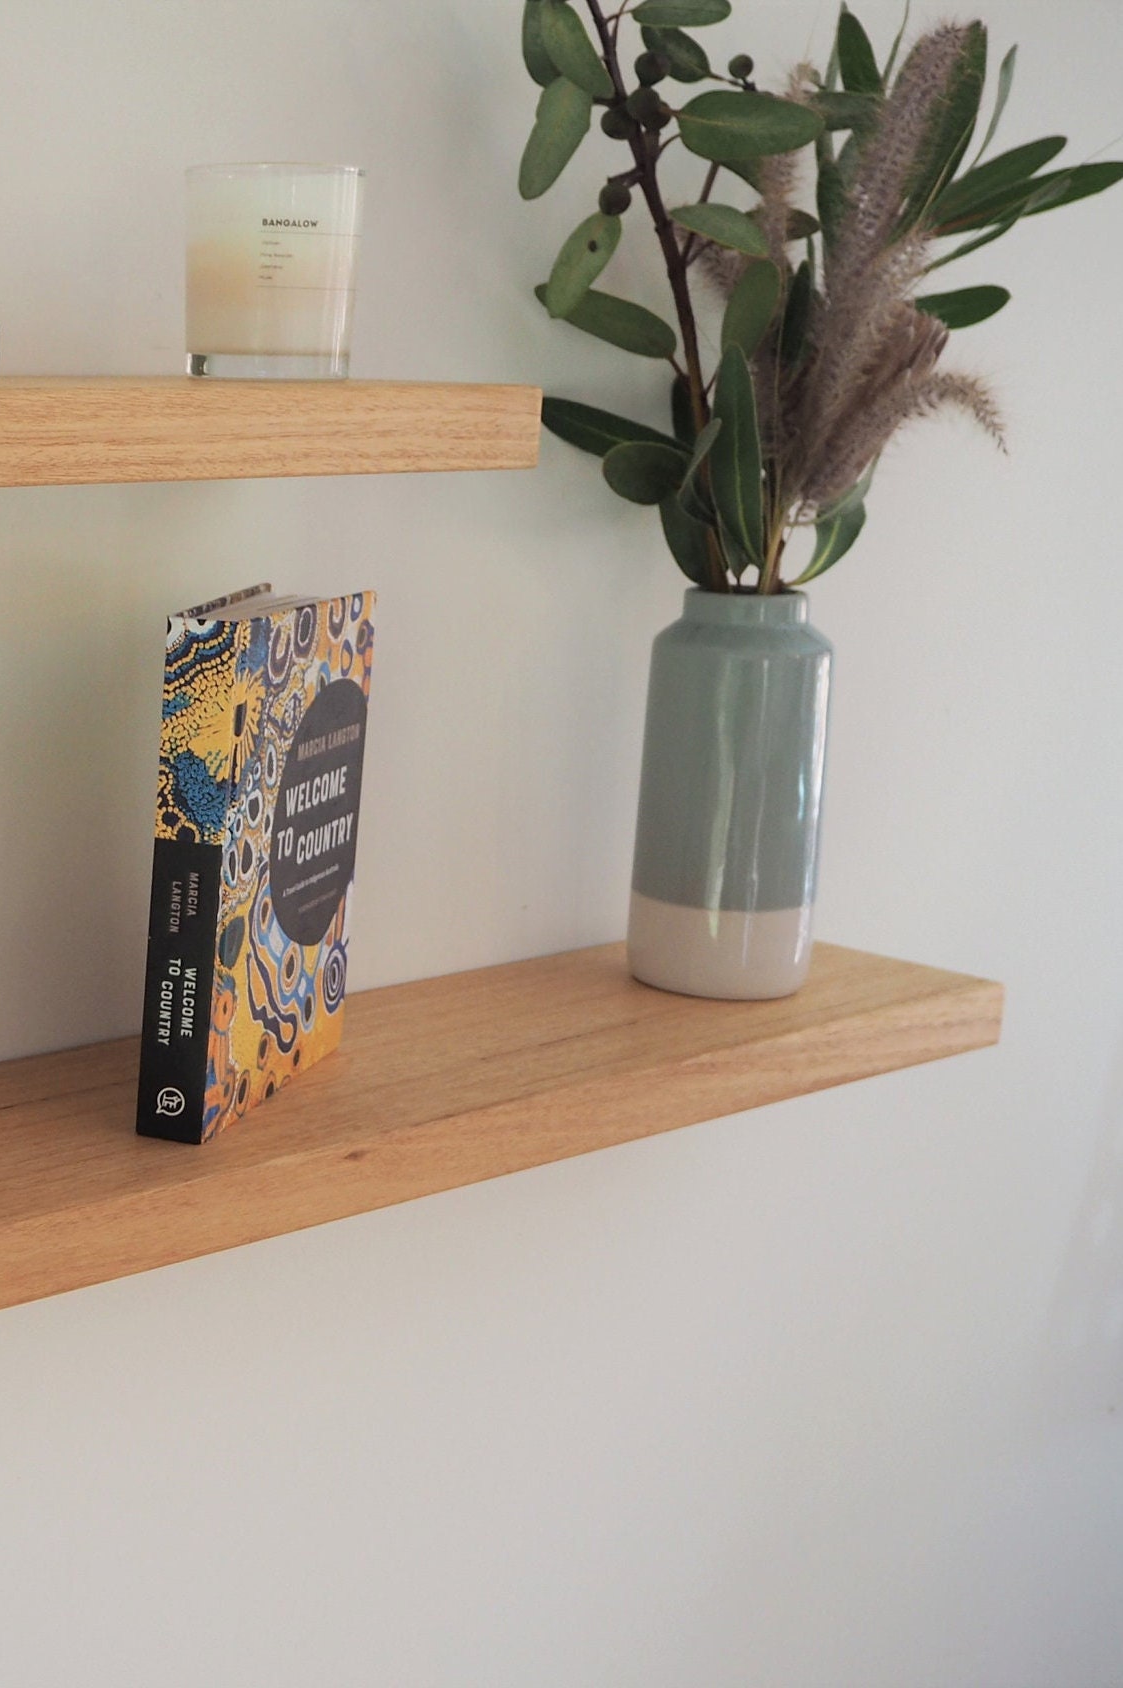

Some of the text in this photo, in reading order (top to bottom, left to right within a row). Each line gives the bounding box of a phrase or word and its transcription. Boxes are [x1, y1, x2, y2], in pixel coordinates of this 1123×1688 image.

[297, 723, 361, 761] MARCIA LANGTON
[286, 766, 348, 817] WELCOME
[277, 813, 354, 865] TO COUNTRY
[169, 881, 182, 934] LANGTON
[187, 872, 199, 916] MARCIA
[157, 958, 182, 1046] TO COUNTRY
[180, 968, 197, 1038] WELCOME
